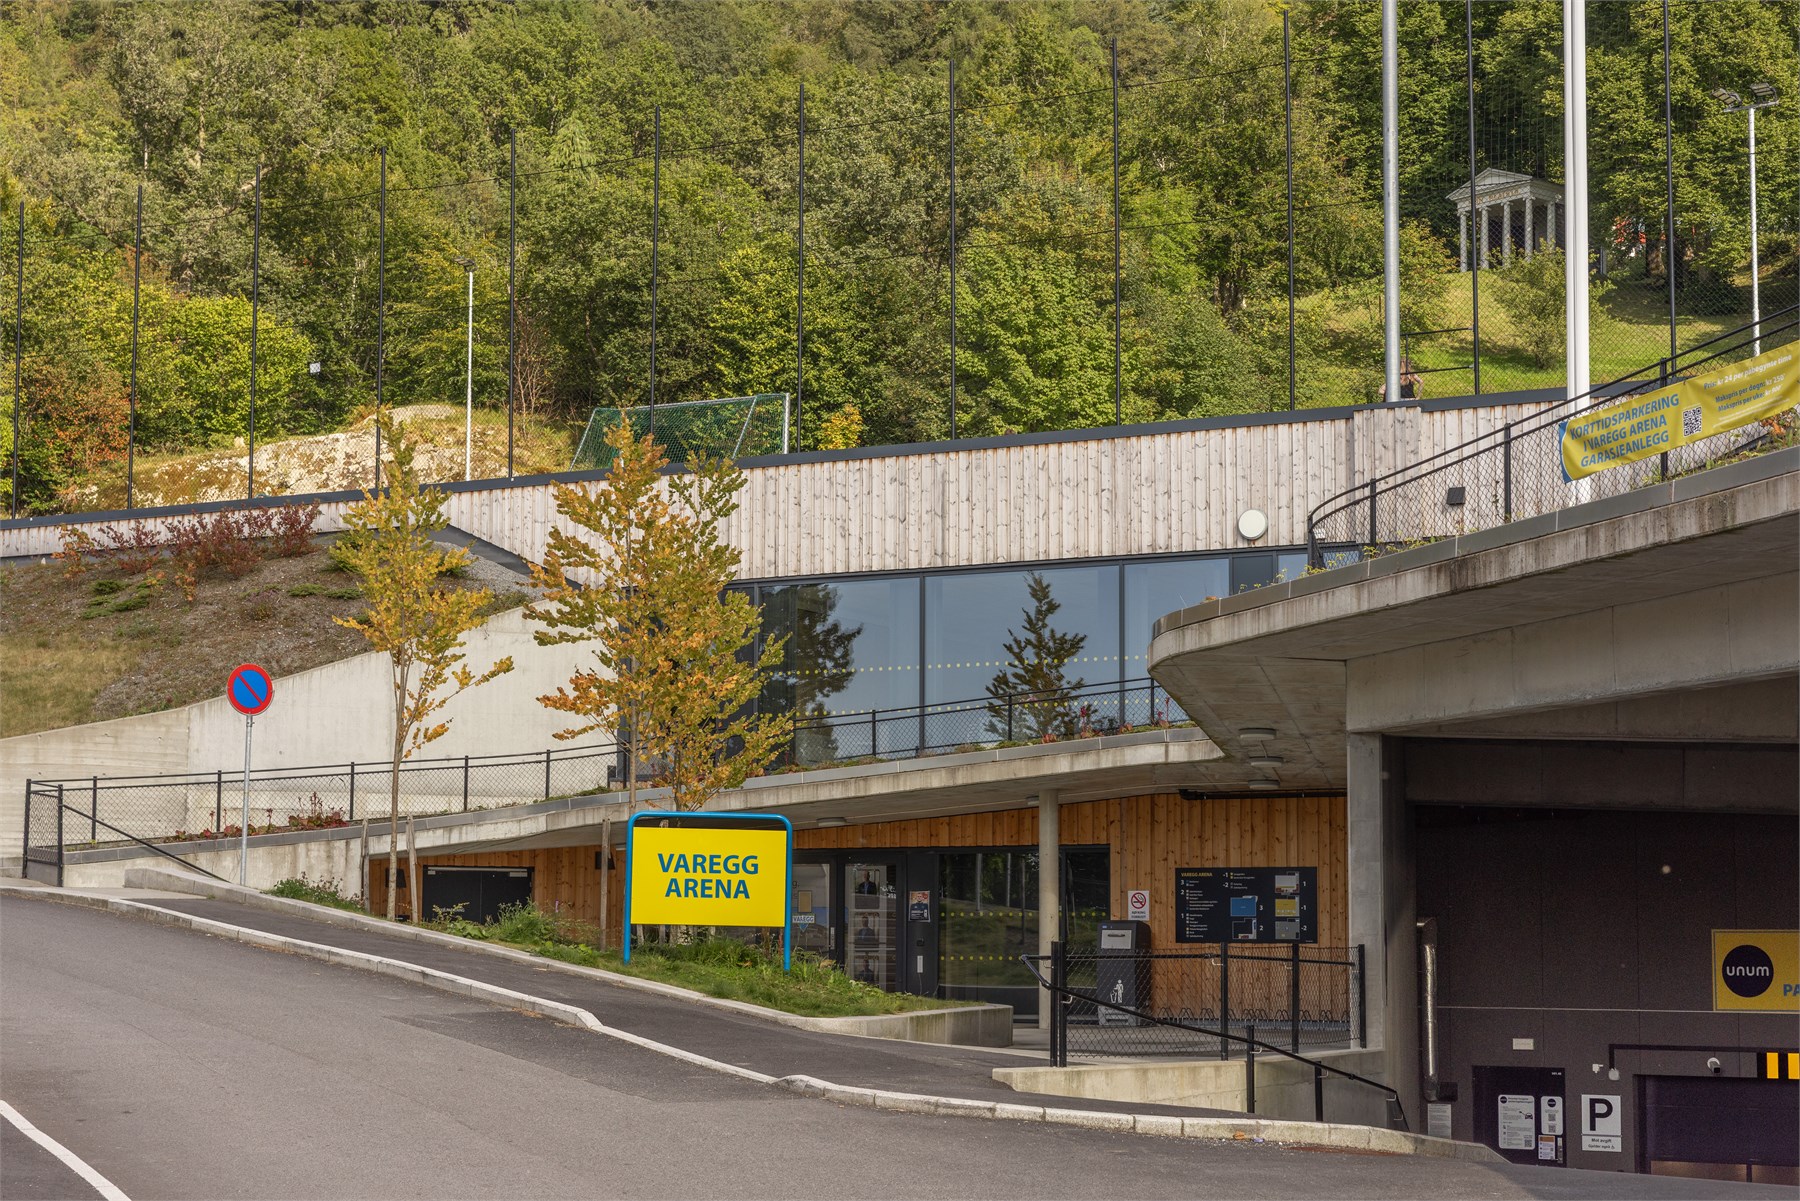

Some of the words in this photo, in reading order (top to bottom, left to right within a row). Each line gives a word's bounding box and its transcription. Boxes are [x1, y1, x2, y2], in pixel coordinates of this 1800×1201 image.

[1703, 382, 1717, 390] Pris:
[1717, 378, 1724, 386] kr
[1724, 374, 1733, 383] 24
[1733, 372, 1744, 381] per
[1777, 354, 1792, 366] time
[1715, 392, 1739, 403] Makspris
[1738, 387, 1748, 396] per
[1765, 378, 1773, 386] kr
[1742, 396, 1752, 405] per
[1569, 393, 1680, 441] KORTTIDSPARKERING
[1583, 440, 1588, 452] I
[1587, 427, 1627, 451] VAREGG
[1629, 414, 1668, 437] ARENA
[1580, 429, 1669, 468] GARASJEANLEGG
[657, 853, 759, 875] VAREGG
[664, 878, 750, 899] ARENA
[1726, 966, 1770, 977] unum
[1589, 1098, 1613, 1131] P
